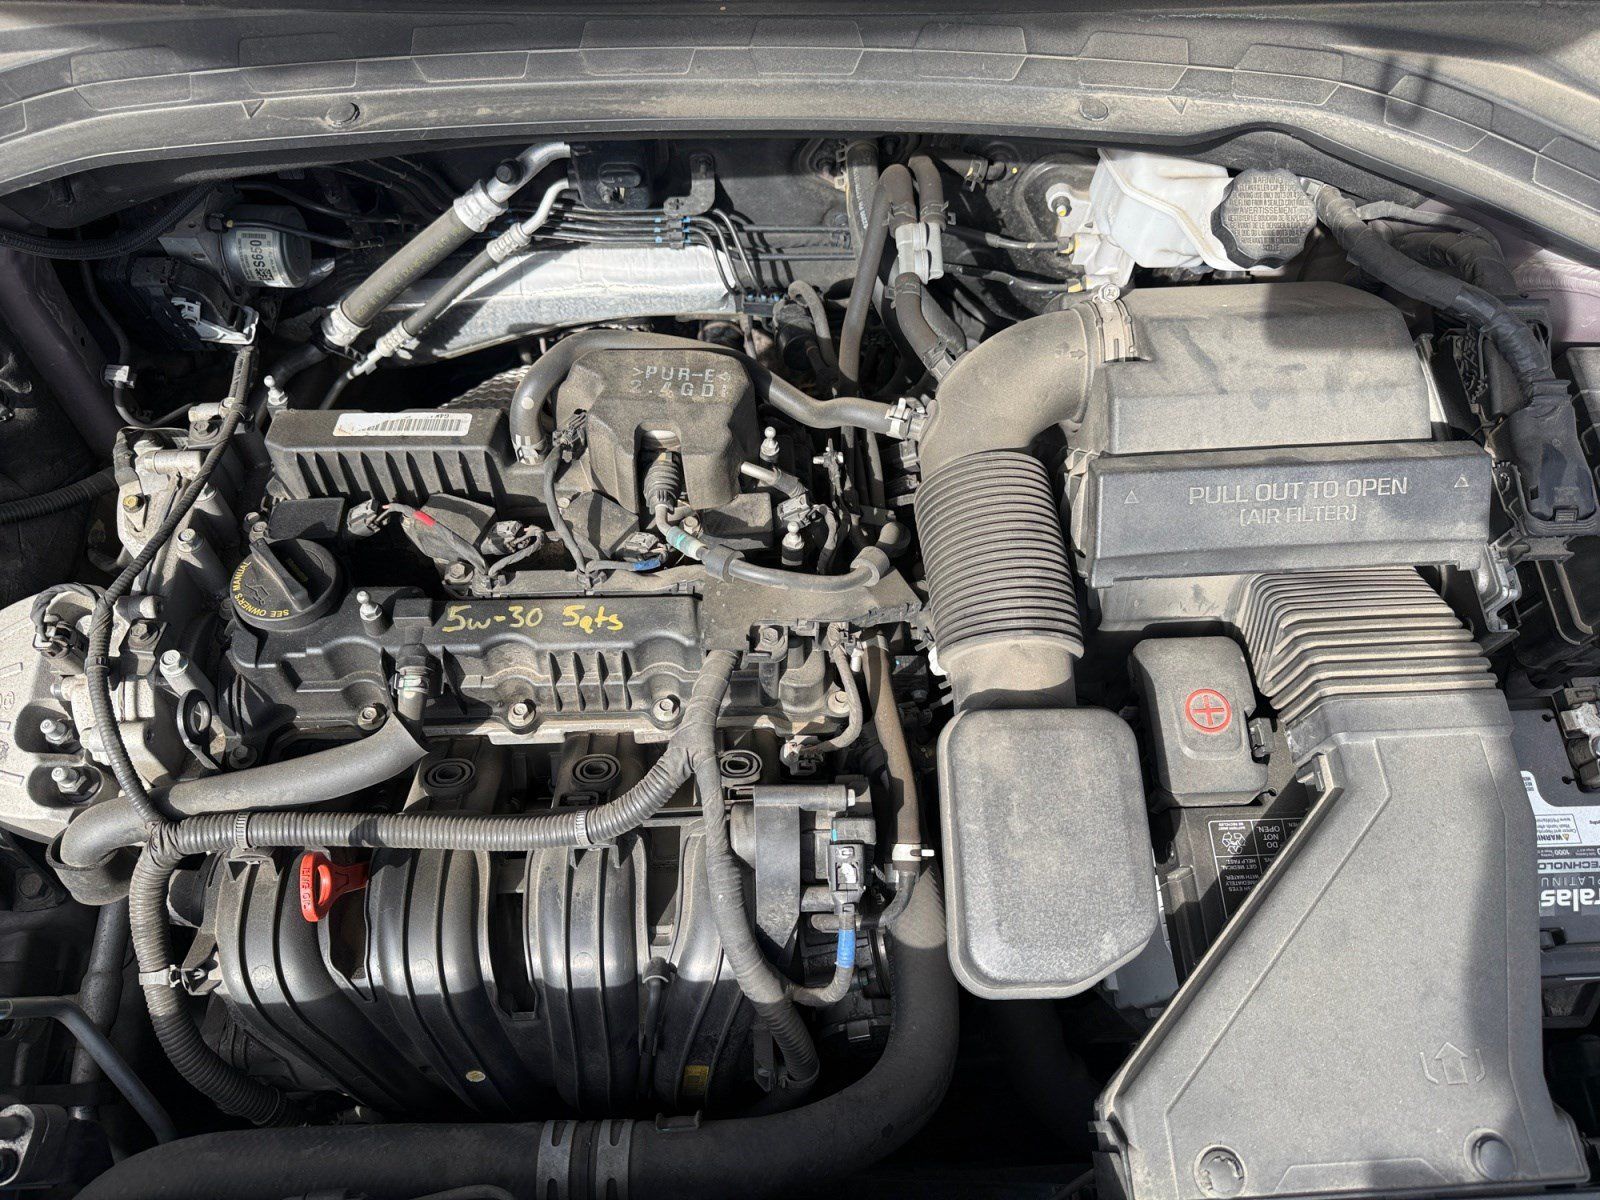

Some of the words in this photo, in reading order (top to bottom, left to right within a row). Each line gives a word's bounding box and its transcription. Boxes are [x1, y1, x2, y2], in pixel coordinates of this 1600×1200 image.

[250, 240, 265, 267] S650
[1189, 485, 1248, 504] PULL
[1255, 482, 1303, 502] OUT
[1309, 480, 1339, 499] TO
[1346, 476, 1408, 498] OPEN
[232, 561, 252, 592] MANUAL
[234, 592, 266, 616] OWNER'S
[270, 609, 290, 618] SEE
[562, 604, 624, 634] 5qts
